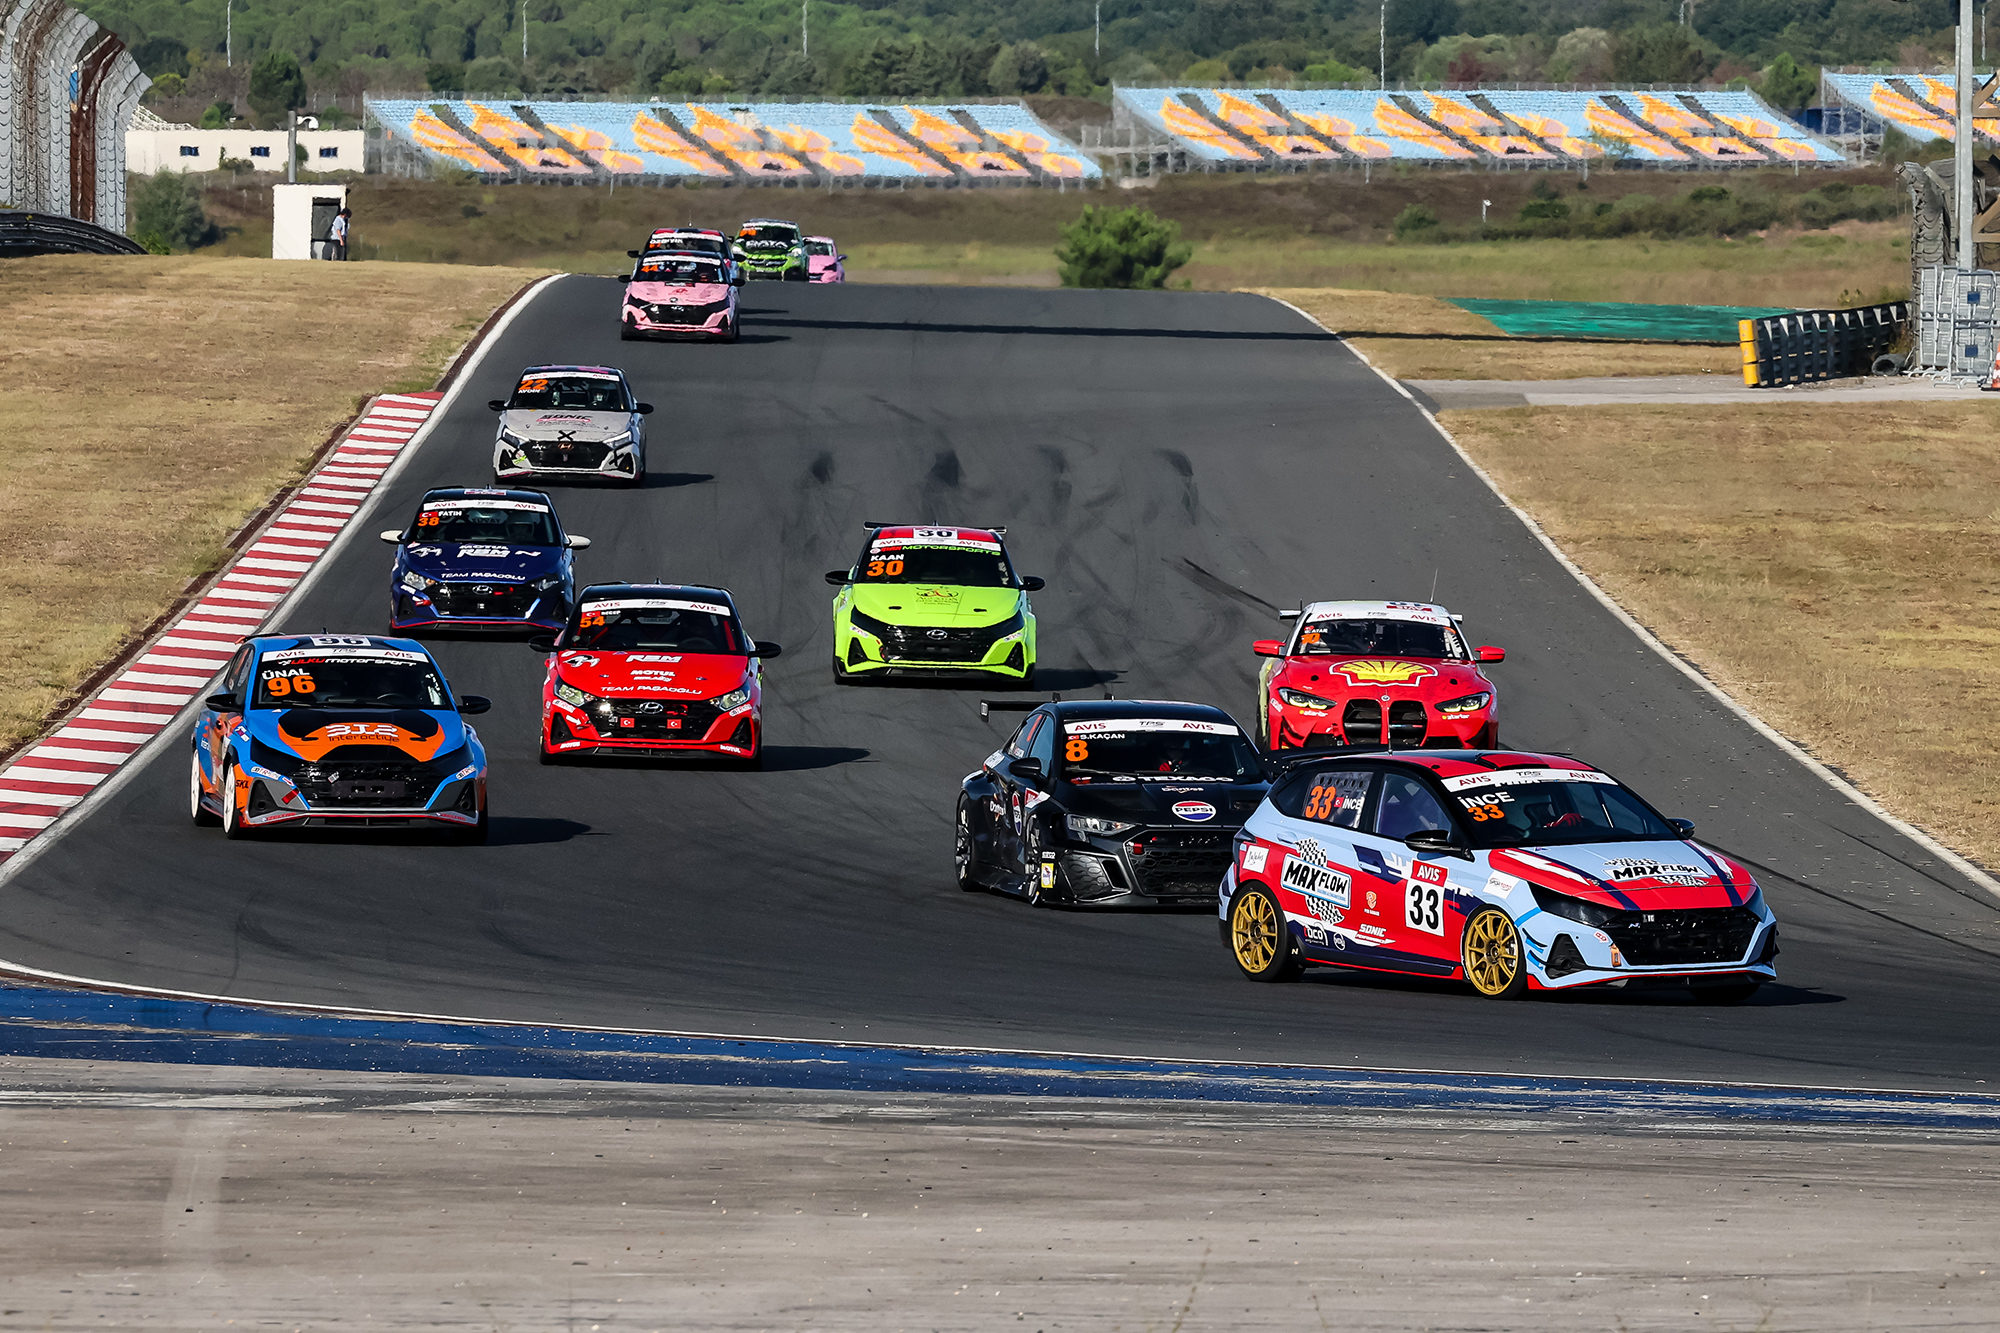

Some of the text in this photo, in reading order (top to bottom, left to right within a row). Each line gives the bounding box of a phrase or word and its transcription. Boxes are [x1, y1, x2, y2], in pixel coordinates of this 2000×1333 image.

[518, 379, 548, 391] 22
[418, 517, 439, 527] 38
[919, 529, 952, 537] 30
[866, 560, 904, 577] 30
[690, 603, 717, 612] AVIS
[580, 616, 605, 628] 54
[1411, 614, 1437, 622] AVIS
[384, 651, 413, 659] AVIS
[261, 668, 310, 680] ÜNAL
[267, 675, 316, 697] 96
[1075, 722, 1106, 731] AVIS
[1183, 722, 1214, 731] AVIS
[1065, 740, 1089, 762] 8
[1459, 775, 1491, 786] AVIS
[1569, 772, 1600, 780] AVIS
[1305, 786, 1362, 819] 33 İNCE
[1457, 791, 1515, 808] İNCE
[1467, 804, 1505, 822] 33
[1284, 861, 1321, 892] MAX
[1318, 872, 1348, 895] FLOW
[1417, 865, 1440, 882] AVIS
[1613, 865, 1698, 880] MAX FLOW
[1409, 885, 1439, 930] 33
[1359, 924, 1387, 937] SONIC
